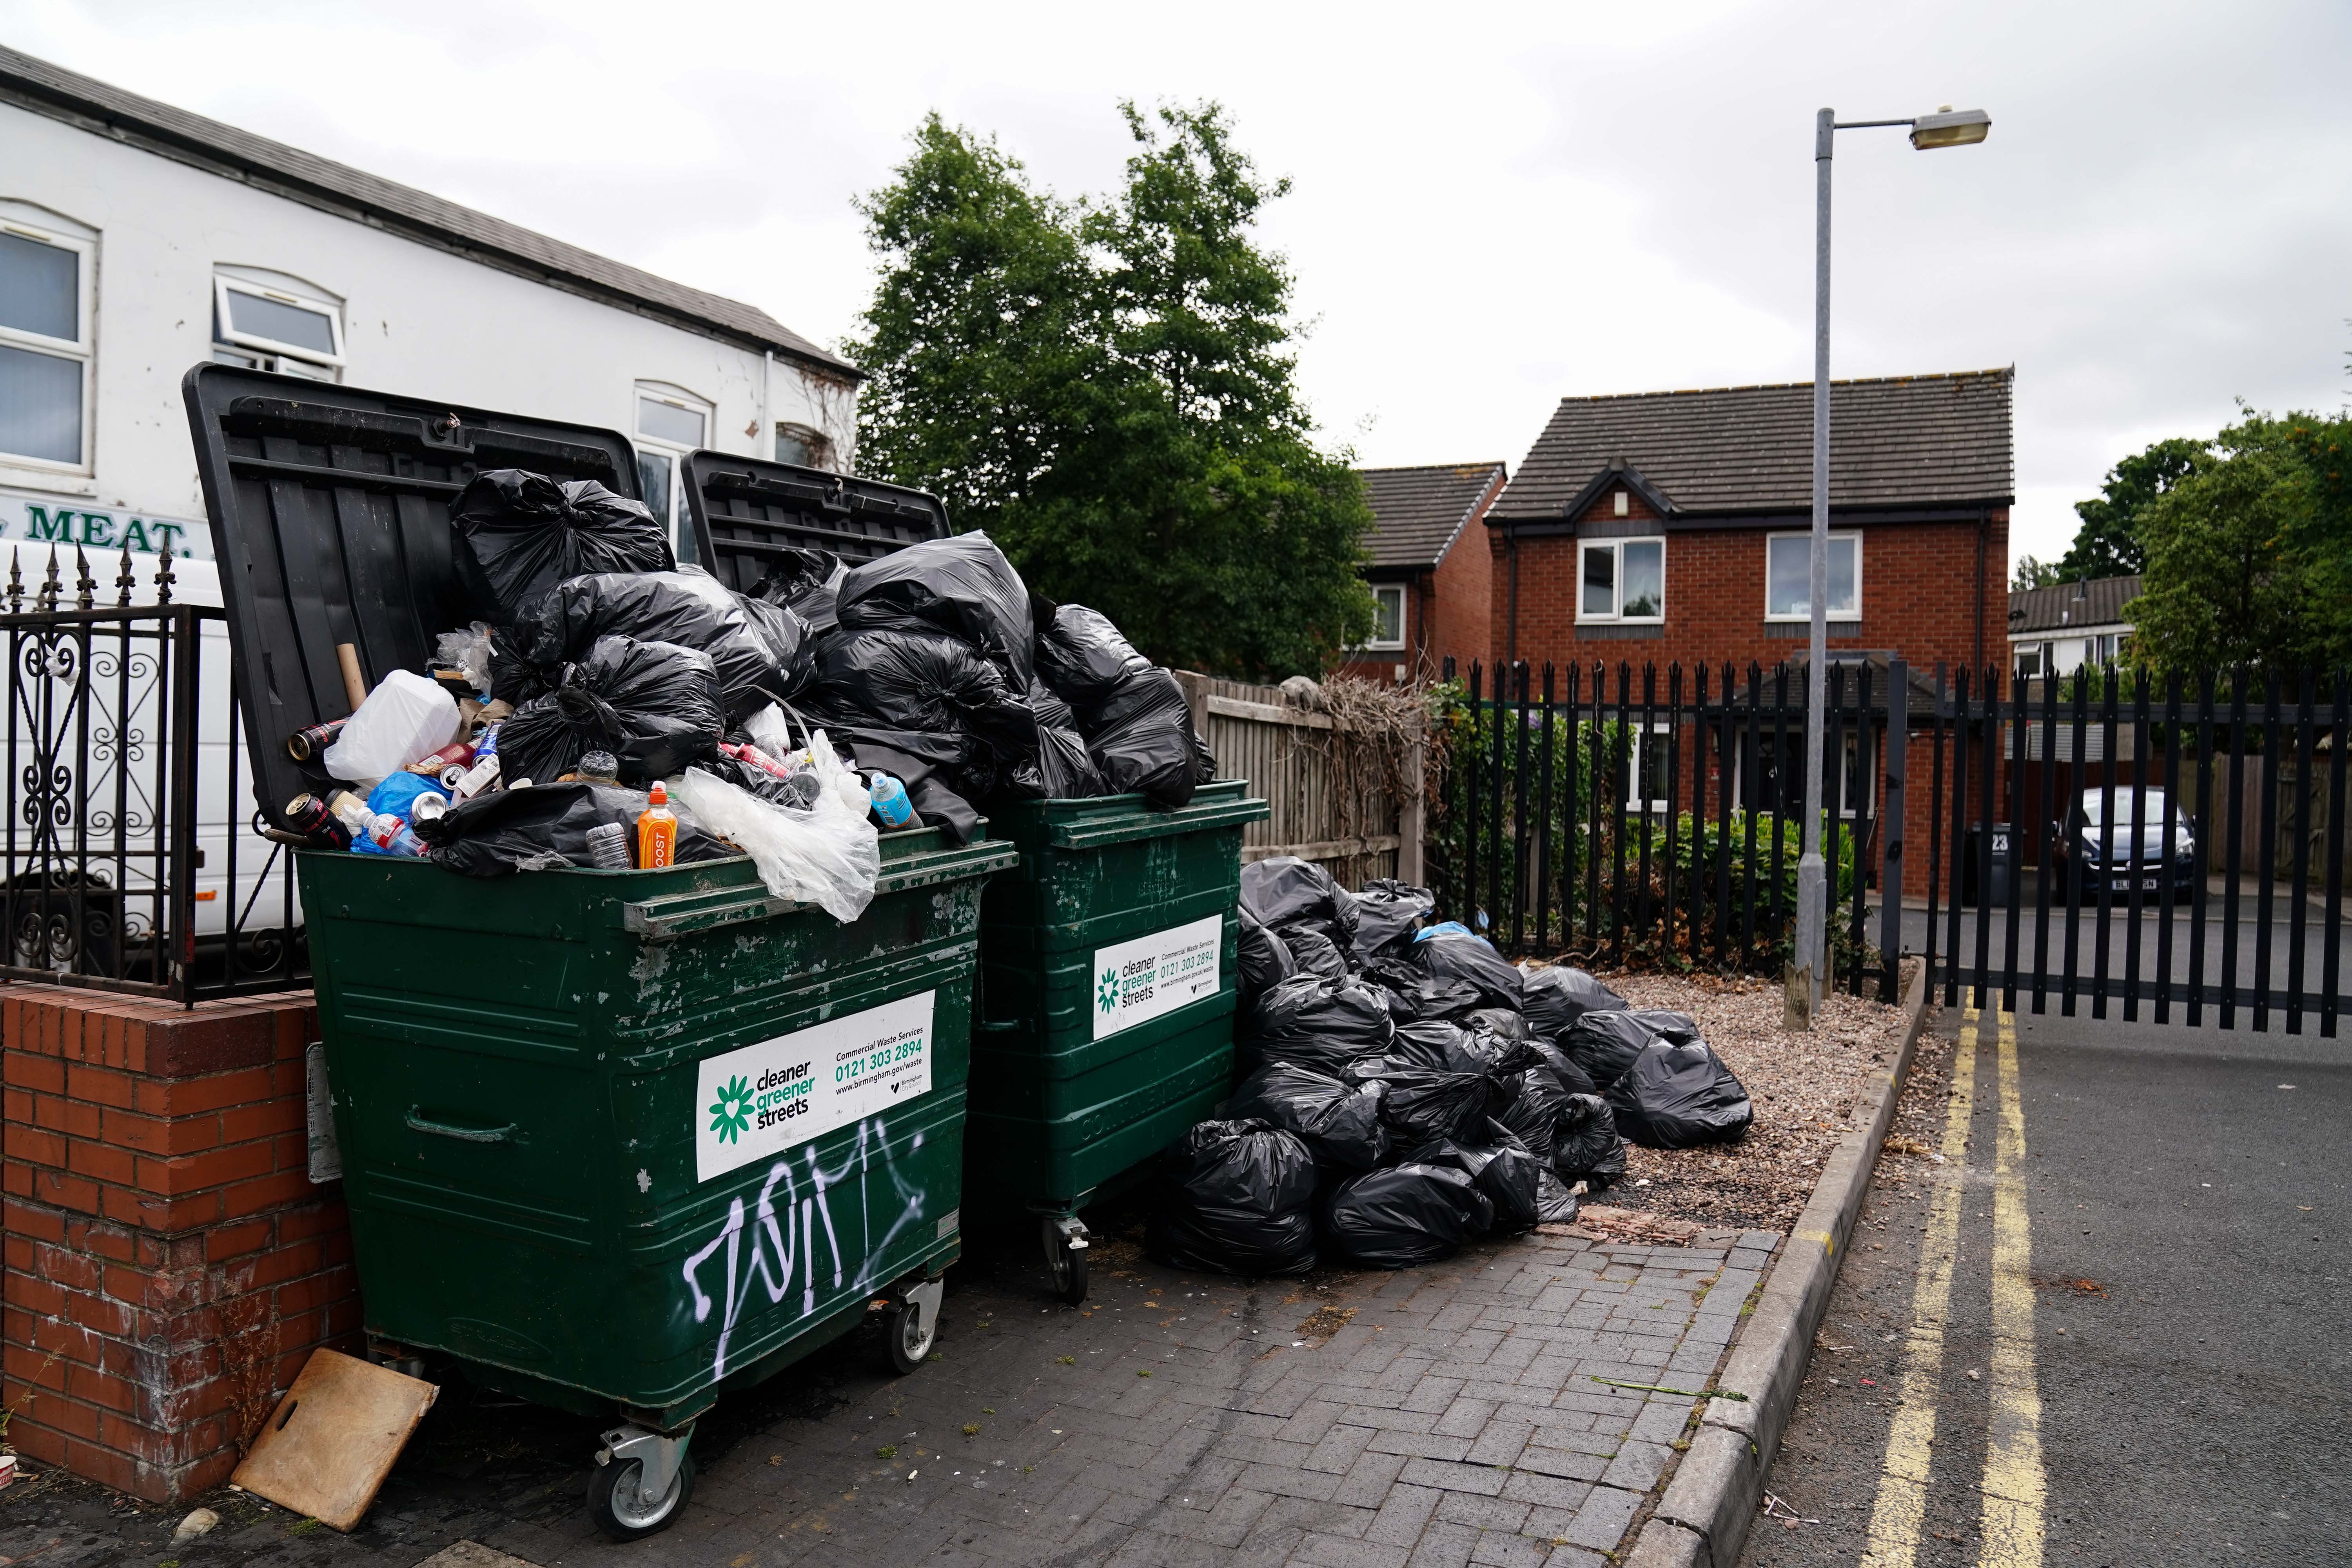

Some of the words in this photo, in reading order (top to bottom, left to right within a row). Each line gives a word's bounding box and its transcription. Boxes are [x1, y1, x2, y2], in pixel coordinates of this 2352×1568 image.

[1161, 961, 1178, 978] 0121
[1181, 956, 1194, 971] 303
[1197, 949, 1214, 966] 2894
[1162, 947, 1186, 960] Commercial
[1187, 944, 1198, 953] Waste
[1199, 939, 1214, 949] Services
[1122, 955, 1156, 977] cleaner
[1122, 968, 1156, 995] greener
[1122, 985, 1154, 1008] streets
[836, 1040, 875, 1062] Commercial
[877, 1035, 897, 1051] Waste
[898, 1026, 924, 1043] Services
[757, 1060, 811, 1091] cleaner
[835, 1059, 866, 1083] 0121
[869, 1051, 891, 1071] 303
[895, 1038, 922, 1062] 2894
[835, 1056, 922, 1096] www.birmingham.gov/waste
[901, 1074, 922, 1085] Birmingham
[756, 1076, 815, 1116] greener
[757, 1097, 809, 1130] streets
